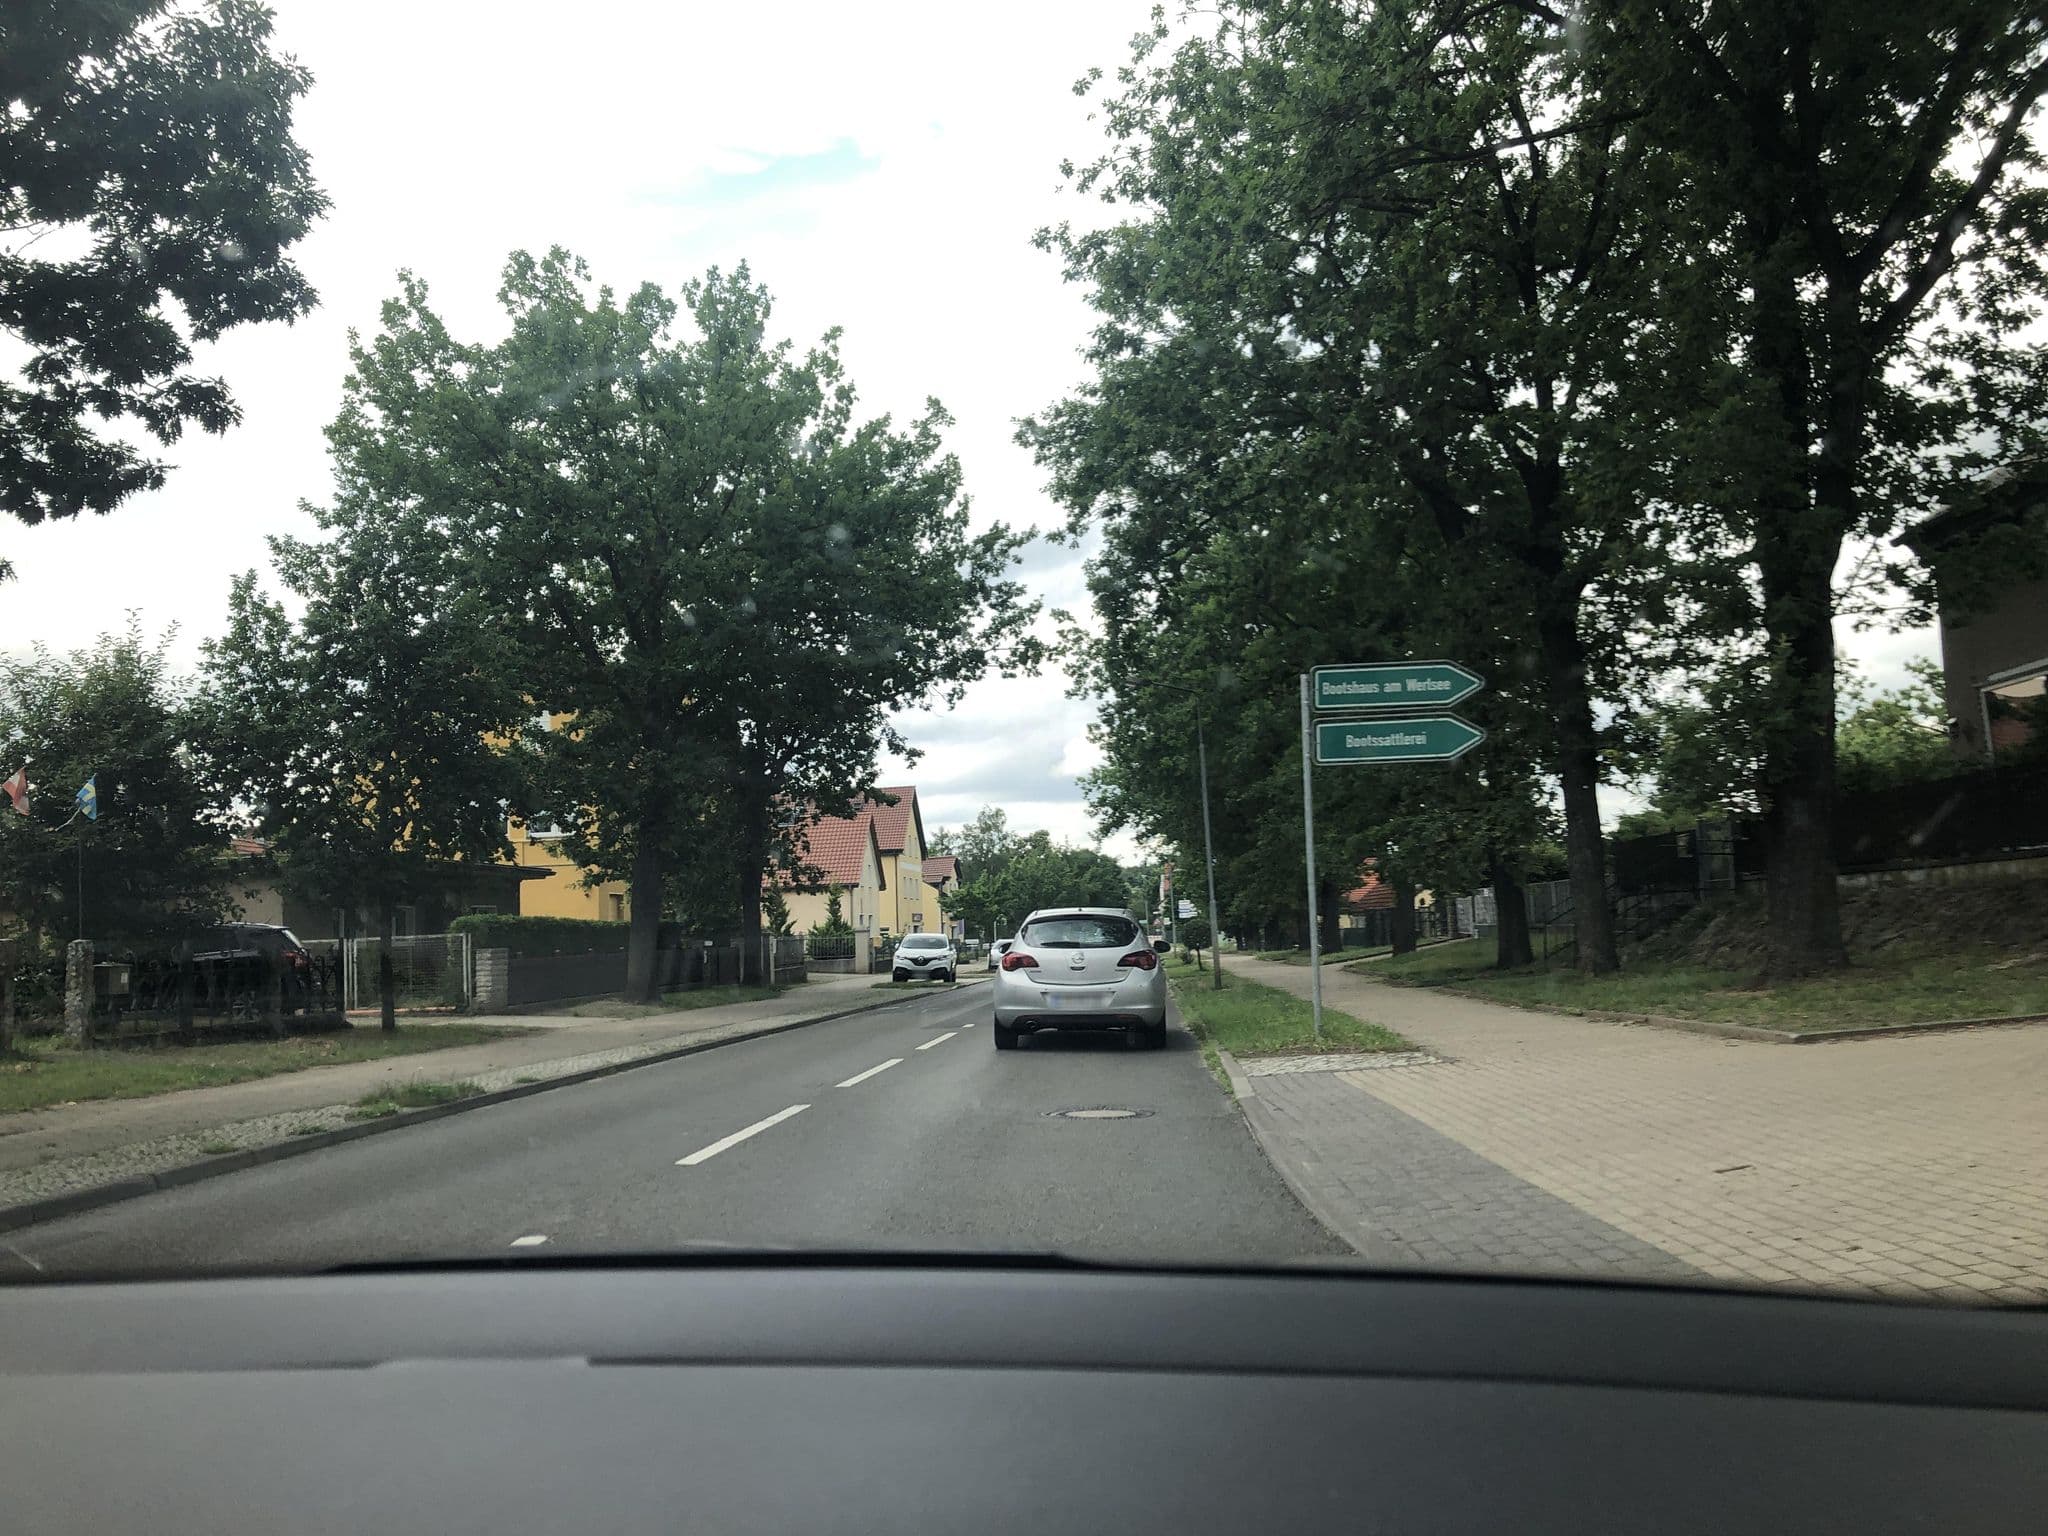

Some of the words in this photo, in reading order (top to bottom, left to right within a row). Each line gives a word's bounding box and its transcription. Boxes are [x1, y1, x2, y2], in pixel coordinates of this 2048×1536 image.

[1322, 681, 1379, 695] Bootshaus
[1383, 682, 1402, 693] am
[1345, 731, 1427, 748] Bootssattlerei
